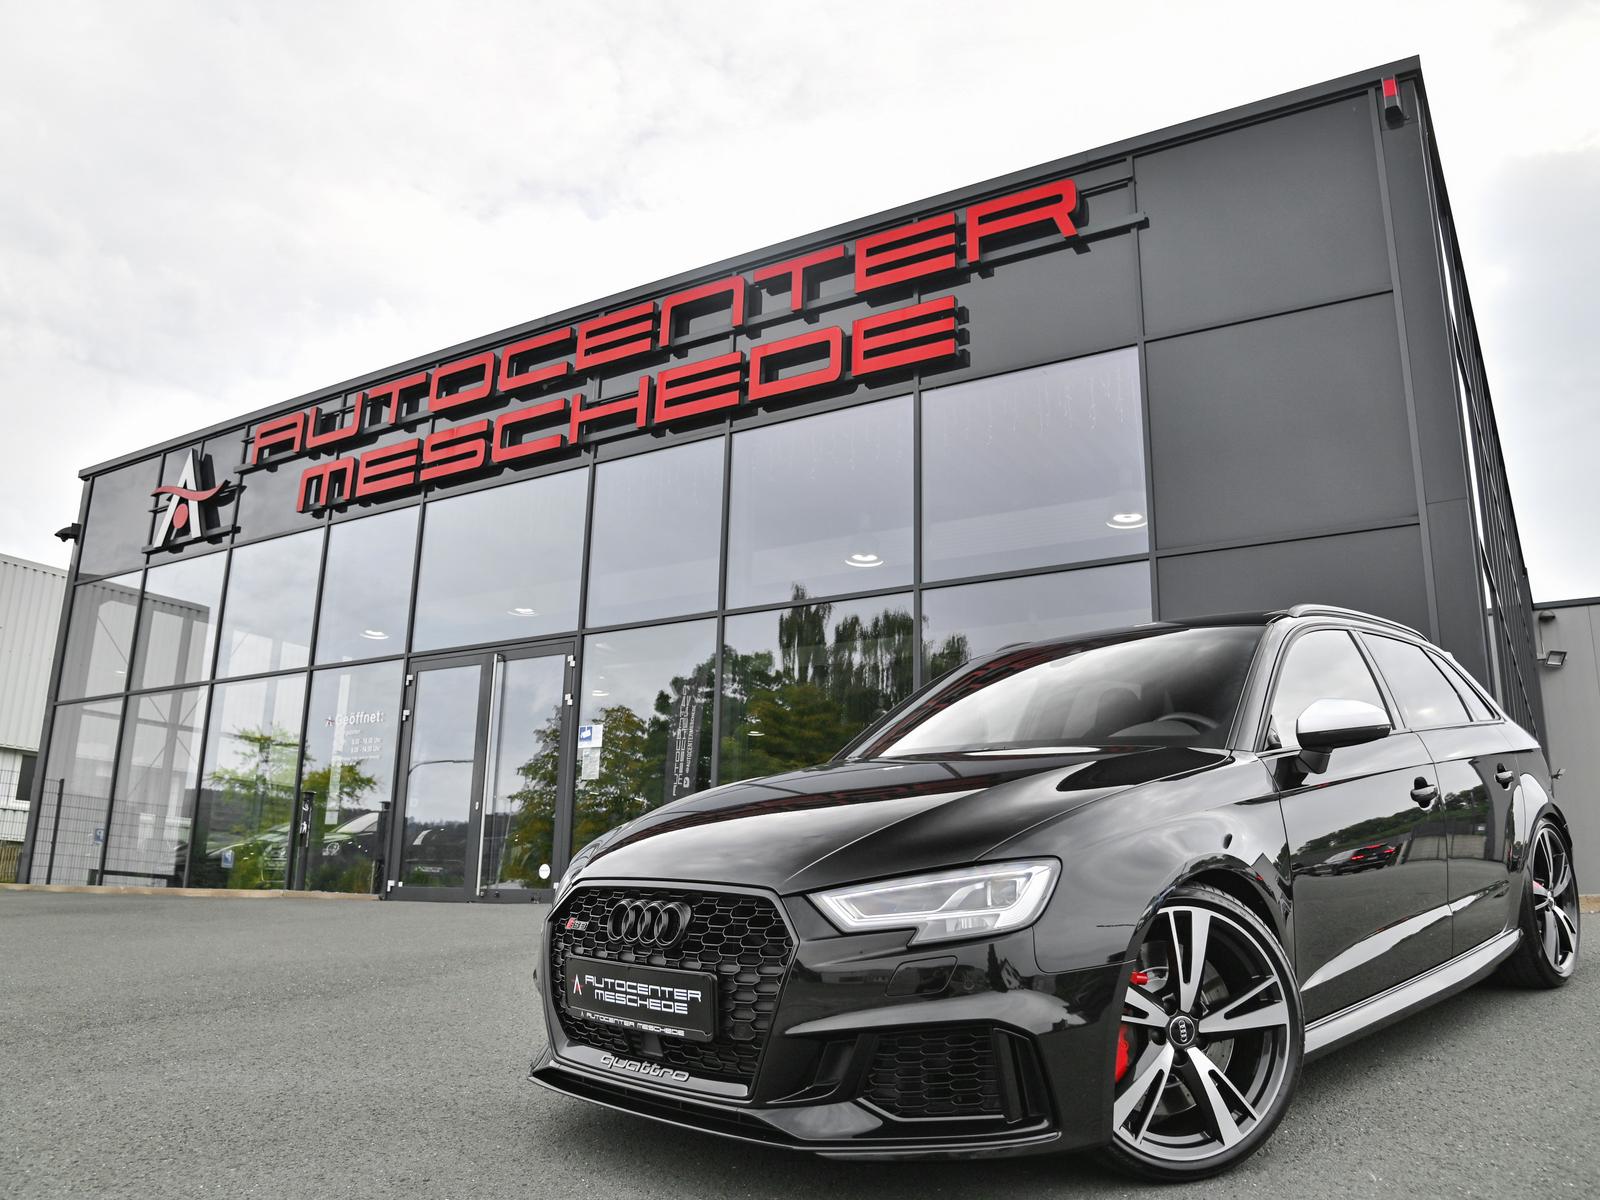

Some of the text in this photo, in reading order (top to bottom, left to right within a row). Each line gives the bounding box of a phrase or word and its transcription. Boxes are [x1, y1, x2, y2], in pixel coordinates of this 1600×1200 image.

[252, 178, 1079, 466] AUTOCENTER
[297, 294, 958, 512] MESCHEDE
[584, 974, 702, 1003] AUTOCENTER
[594, 989, 689, 1015] MESCHEDE
[586, 1012, 685, 1037] AUTOCENTER MESCHEDE
[600, 1054, 690, 1082] quattro
